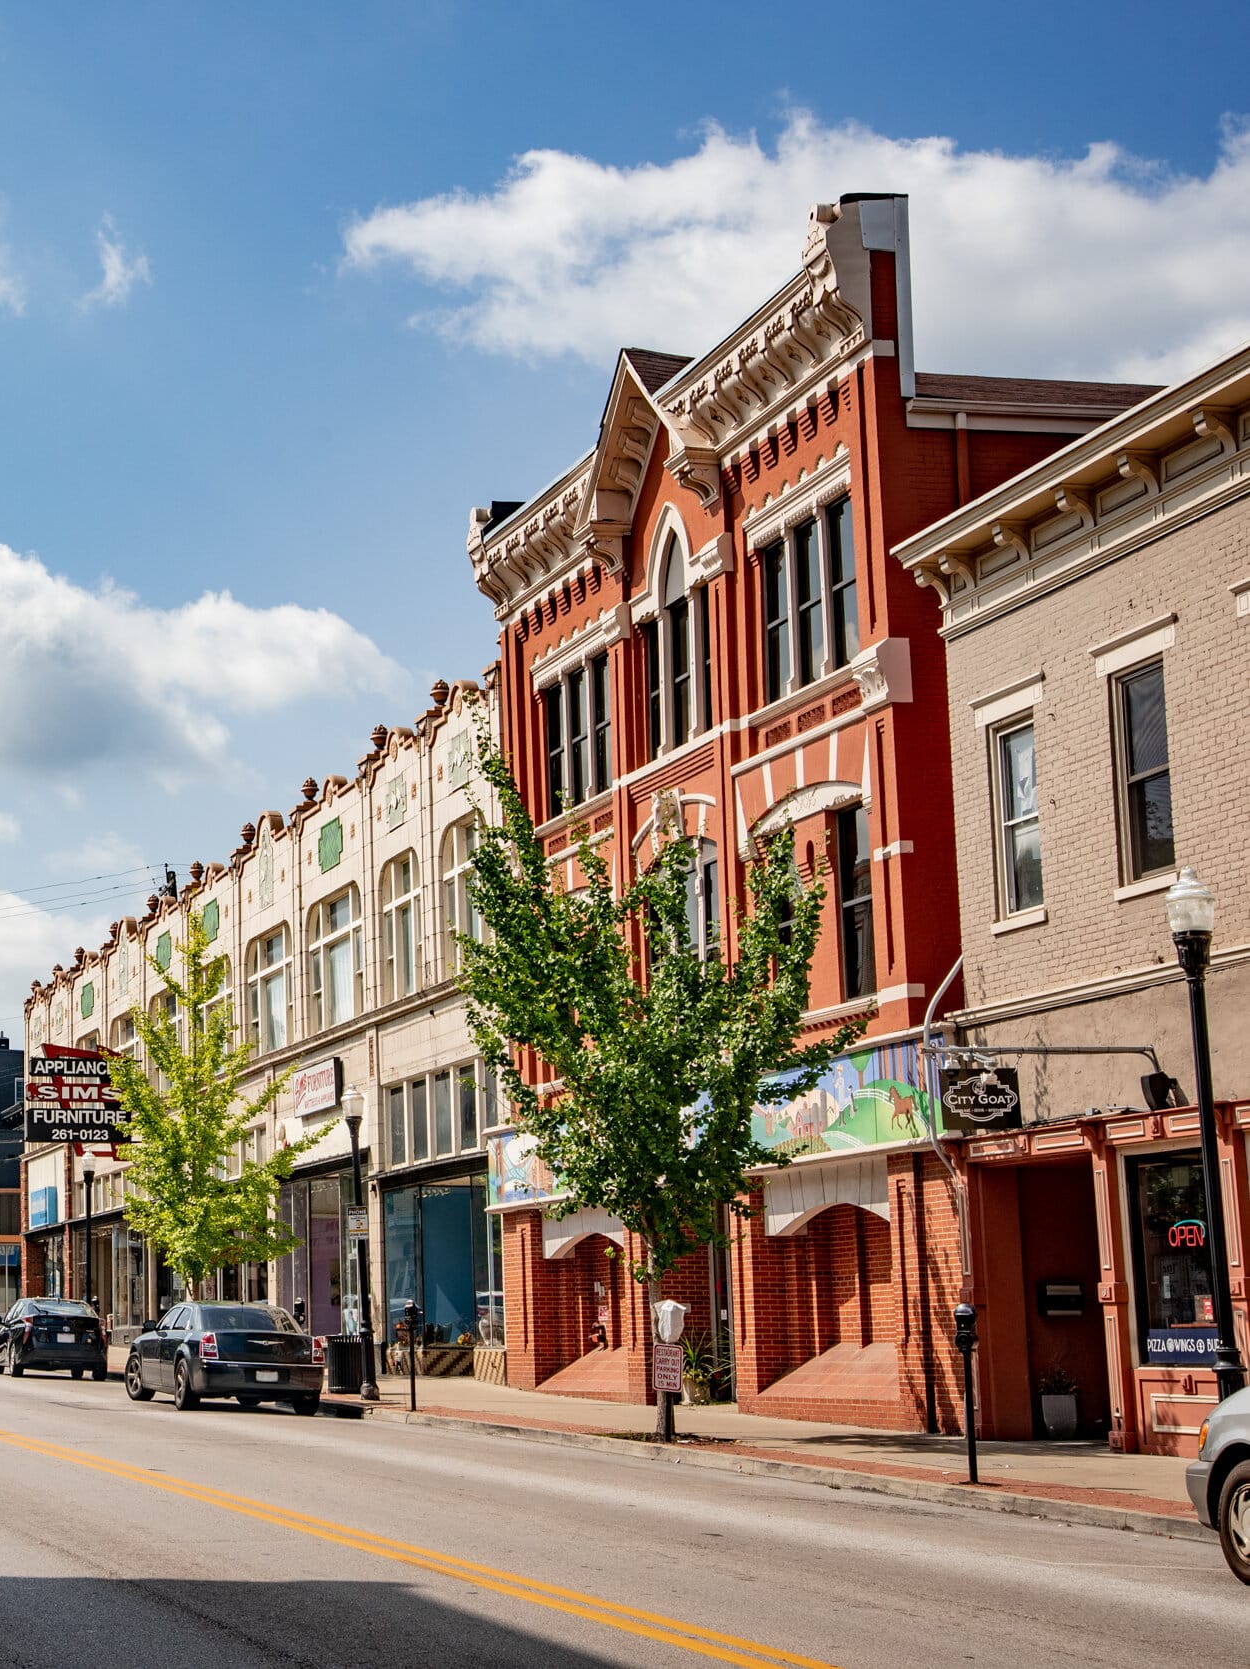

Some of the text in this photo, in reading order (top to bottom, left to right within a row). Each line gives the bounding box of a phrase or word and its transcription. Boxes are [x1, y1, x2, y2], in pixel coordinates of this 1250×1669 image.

[307, 1067, 334, 1092] FURNITURE
[37, 1086, 122, 1100] SIMS
[33, 1110, 127, 1124] FURNITURE
[51, 1129, 109, 1140] 261-0123
[1168, 1226, 1204, 1247] OPEN
[1147, 1339, 1166, 1352] PIZZA
[1174, 1339, 1196, 1352] WINGS
[657, 1366, 679, 1374] PARKING
[657, 1373, 678, 1381] ONLY
